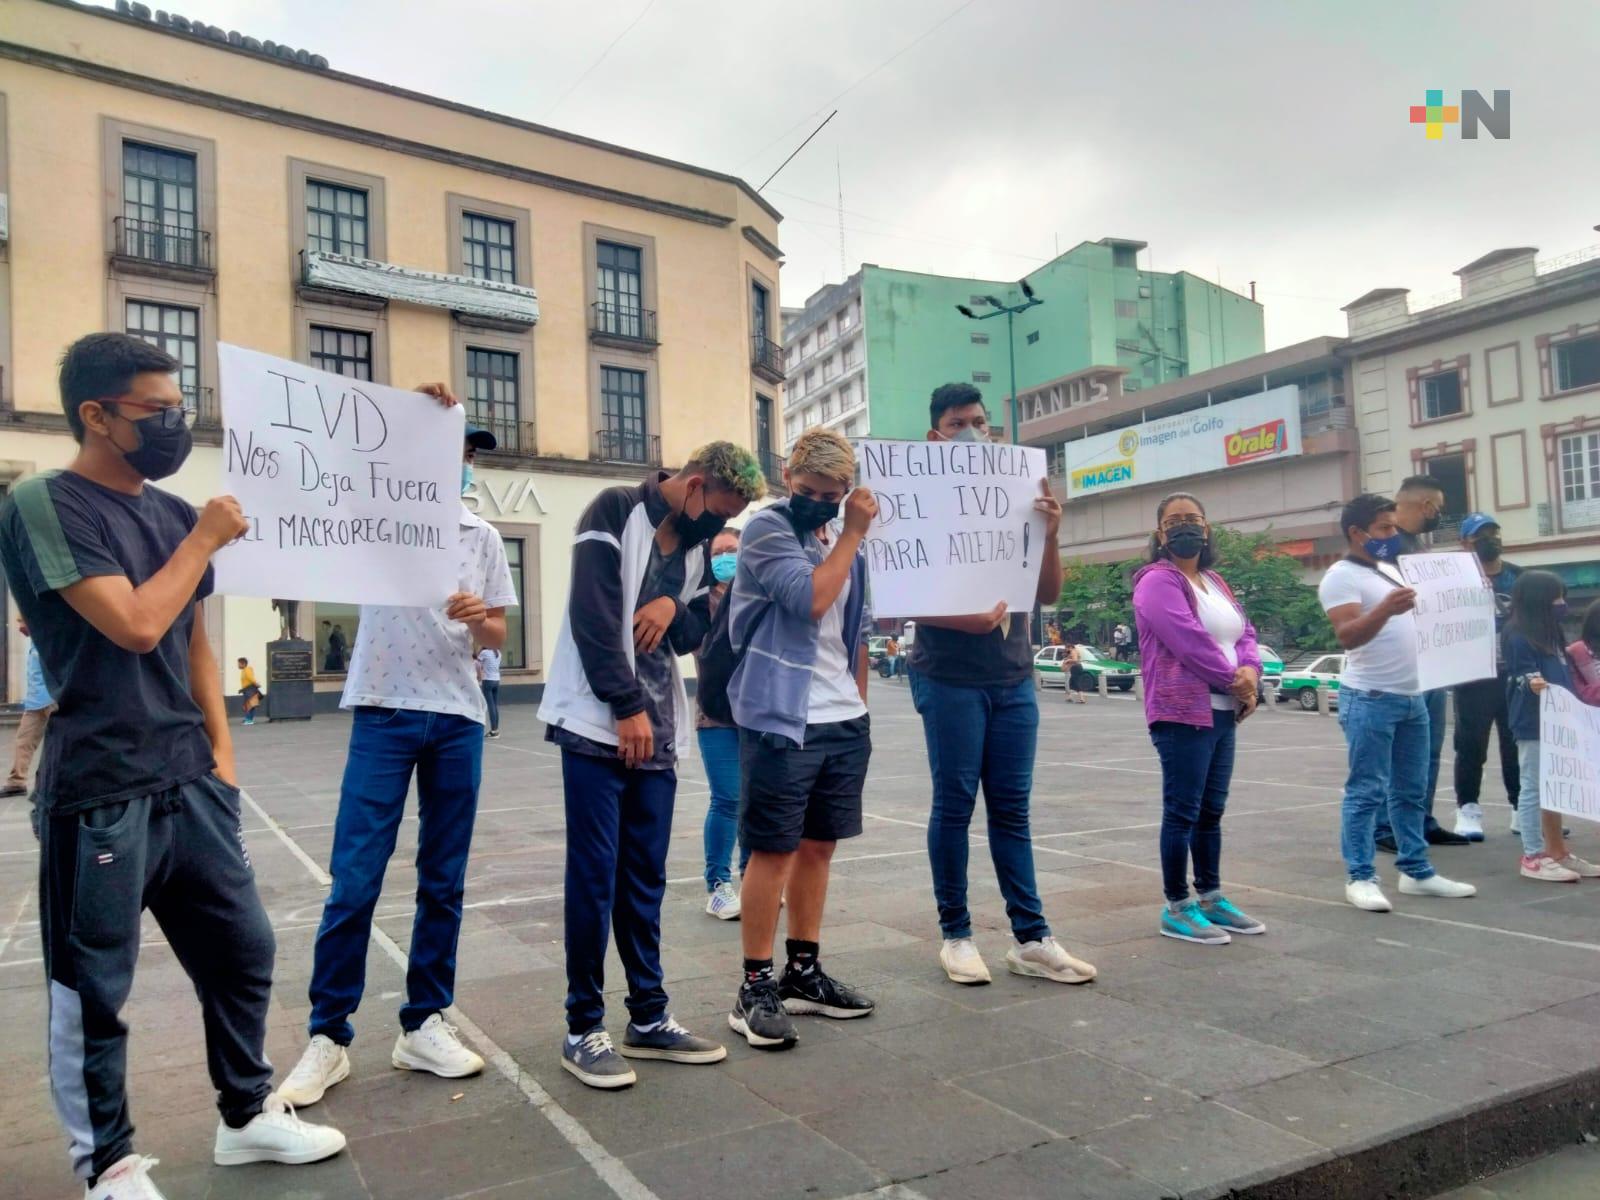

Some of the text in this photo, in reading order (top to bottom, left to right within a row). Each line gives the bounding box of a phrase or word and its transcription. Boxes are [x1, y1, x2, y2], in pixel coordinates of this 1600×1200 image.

[267, 369, 388, 453] IVD
[1140, 416, 1224, 447] Imagen del Golfo
[227, 428, 441, 507] Nos Deja Fuera
[863, 443, 1031, 480] NEGLIGENCIA
[1082, 465, 1132, 489] IMAGEN
[873, 485, 1011, 528] DEL IVD
[278, 514, 447, 550] MACROREGIONAL
[869, 537, 930, 572] PARA
